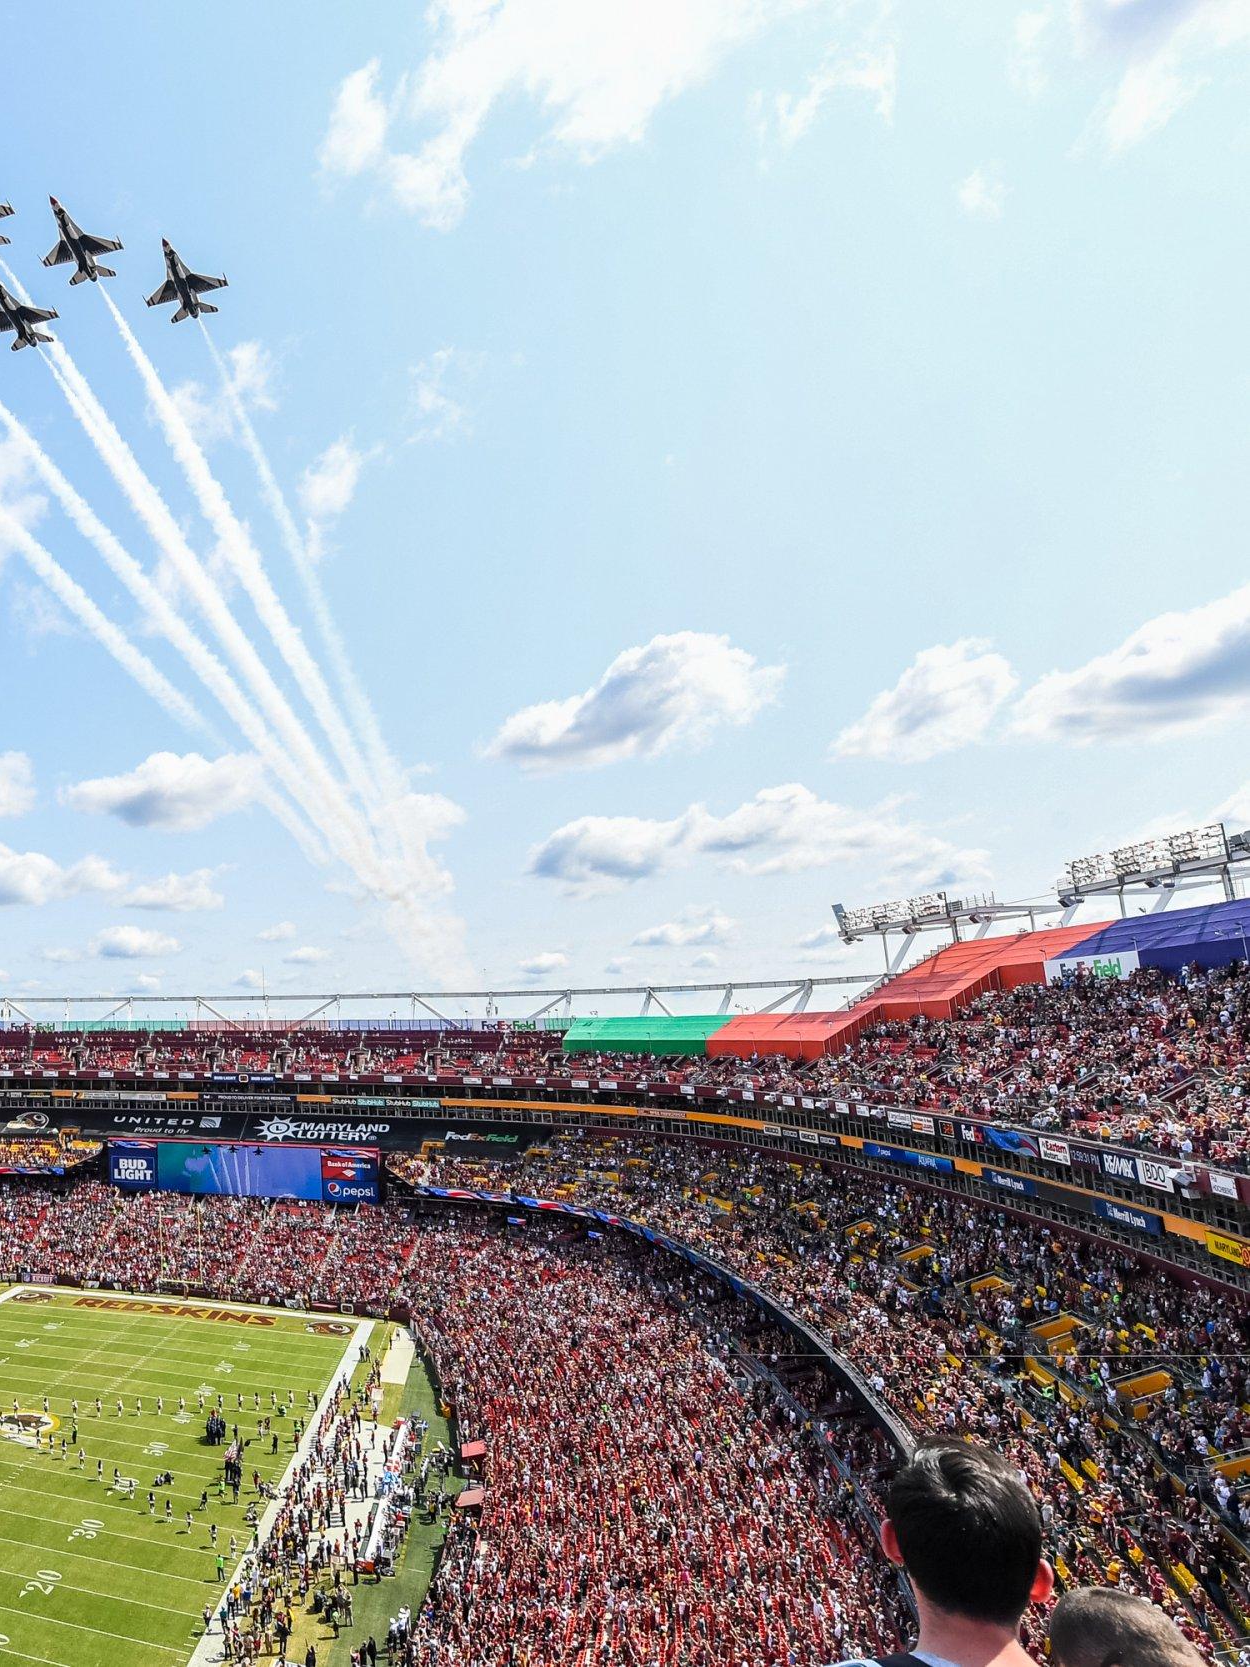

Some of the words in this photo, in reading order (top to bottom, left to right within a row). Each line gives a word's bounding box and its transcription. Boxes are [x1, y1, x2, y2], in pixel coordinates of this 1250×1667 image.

[481, 1020, 536, 1031] FedExField
[357, 1098, 385, 1106] StubHub
[386, 1099, 411, 1107] StubHub
[411, 1100, 439, 1108] StubHub
[113, 1116, 194, 1125] UNITED
[299, 1122, 390, 1132] MARYLAND
[297, 1131, 371, 1141] LOTTERY
[445, 1131, 518, 1142] FedExField
[961, 1124, 984, 1143] FedEx
[1045, 1140, 1067, 1154] Eastern
[119, 1158, 148, 1169] BUD
[1103, 1153, 1135, 1179] RE/MAX
[113, 1168, 152, 1181] LIGHT
[1144, 1163, 1166, 1182] BDO
[1011, 1179, 1024, 1190] Lynch
[343, 1187, 373, 1197] pepsi
[1113, 1208, 1130, 1223] Merrill
[1130, 1212, 1146, 1228] Lynch
[1214, 1240, 1241, 1258] MARYLAND
[71, 1297, 278, 1326] REDSKINS
[72, 1519, 105, 1539] 30
[25, 1569, 62, 1595] 20
